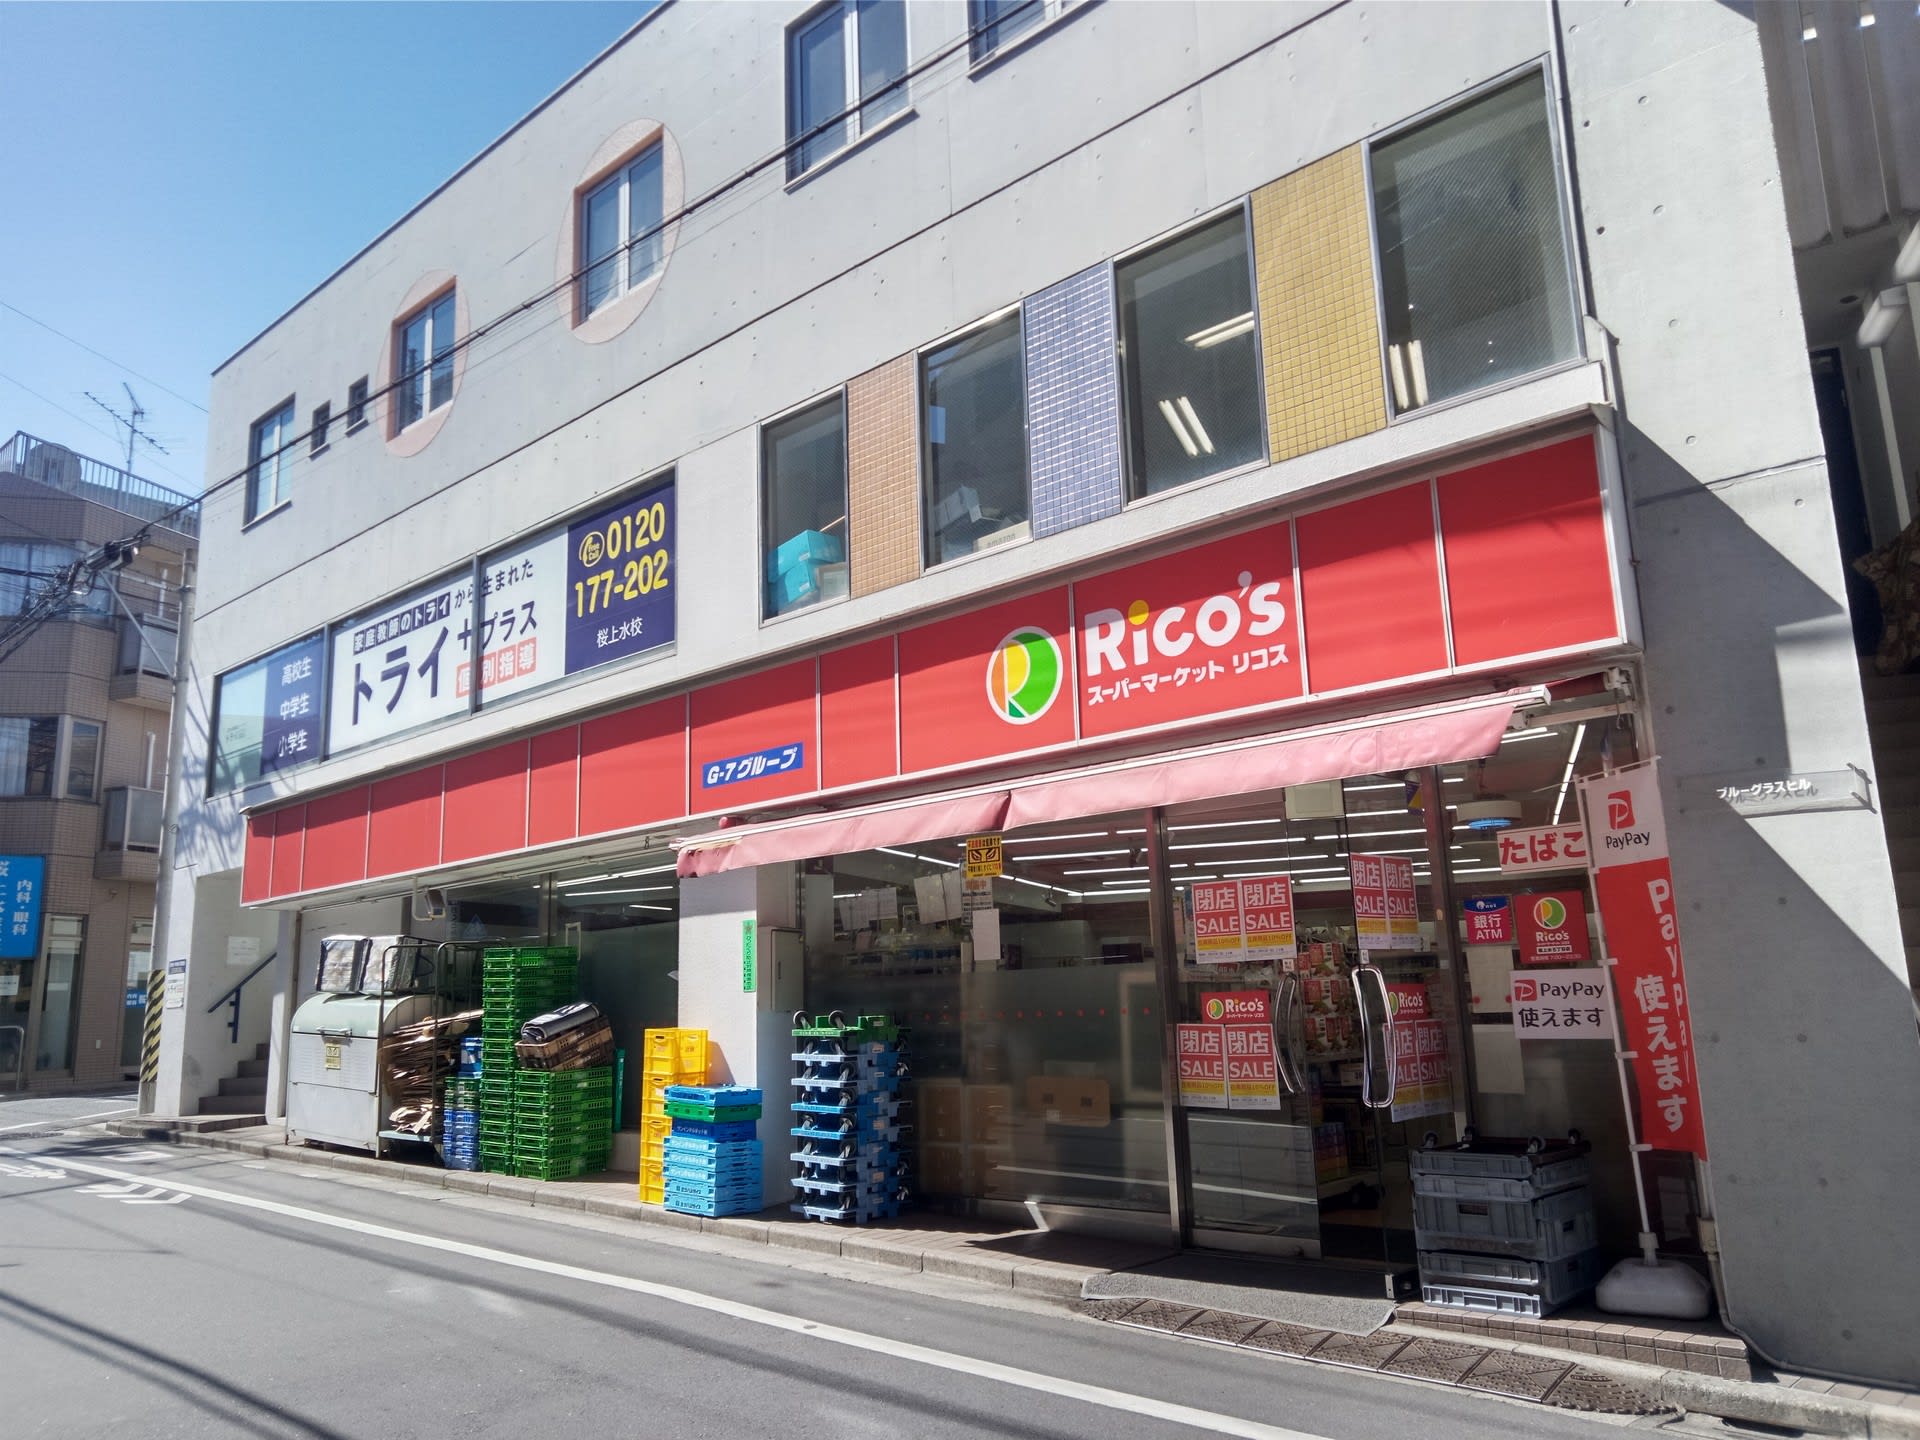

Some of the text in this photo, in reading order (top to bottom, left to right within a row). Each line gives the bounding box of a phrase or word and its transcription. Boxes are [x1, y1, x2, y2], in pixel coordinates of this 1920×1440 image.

[607, 502, 665, 560] 0120
[575, 549, 668, 618] 177-202
[596, 616, 643, 648] 桜上水校
[1084, 570, 1286, 677] Rico's
[281, 655, 312, 687] 高校生
[1087, 643, 1289, 706] スーパーマーケット リコス
[280, 692, 310, 720] 中学生
[278, 729, 308, 758] 小学生
[1499, 831, 1587, 866] たばこ
[1606, 831, 1651, 850] PayPay
[1353, 860, 1380, 887] 閉店
[1384, 863, 1412, 888] 閉店
[1194, 886, 1236, 911] 閉店
[1243, 881, 1287, 907] 閉店
[1356, 895, 1385, 914] SALE
[1388, 897, 1416, 914] SALE
[1197, 916, 1240, 934] SALE
[1245, 911, 1292, 930] SALE
[1473, 914, 1502, 929] 銀行
[1476, 928, 1503, 940] ATM
[1535, 930, 1569, 942] Rico's
[1398, 991, 1424, 1008] Rico's
[1540, 982, 1605, 1000] PayPay
[1225, 998, 1264, 1013] Rico's
[1518, 1007, 1606, 1028] 使えます
[1180, 1030, 1220, 1054] 閉店
[1227, 1030, 1269, 1054] 閉店
[1634, 975, 1687, 1132] 使えます
[1181, 1060, 1223, 1077] SALE
[1229, 1061, 1274, 1078] SALE
[1395, 1062, 1419, 1083] ALE
